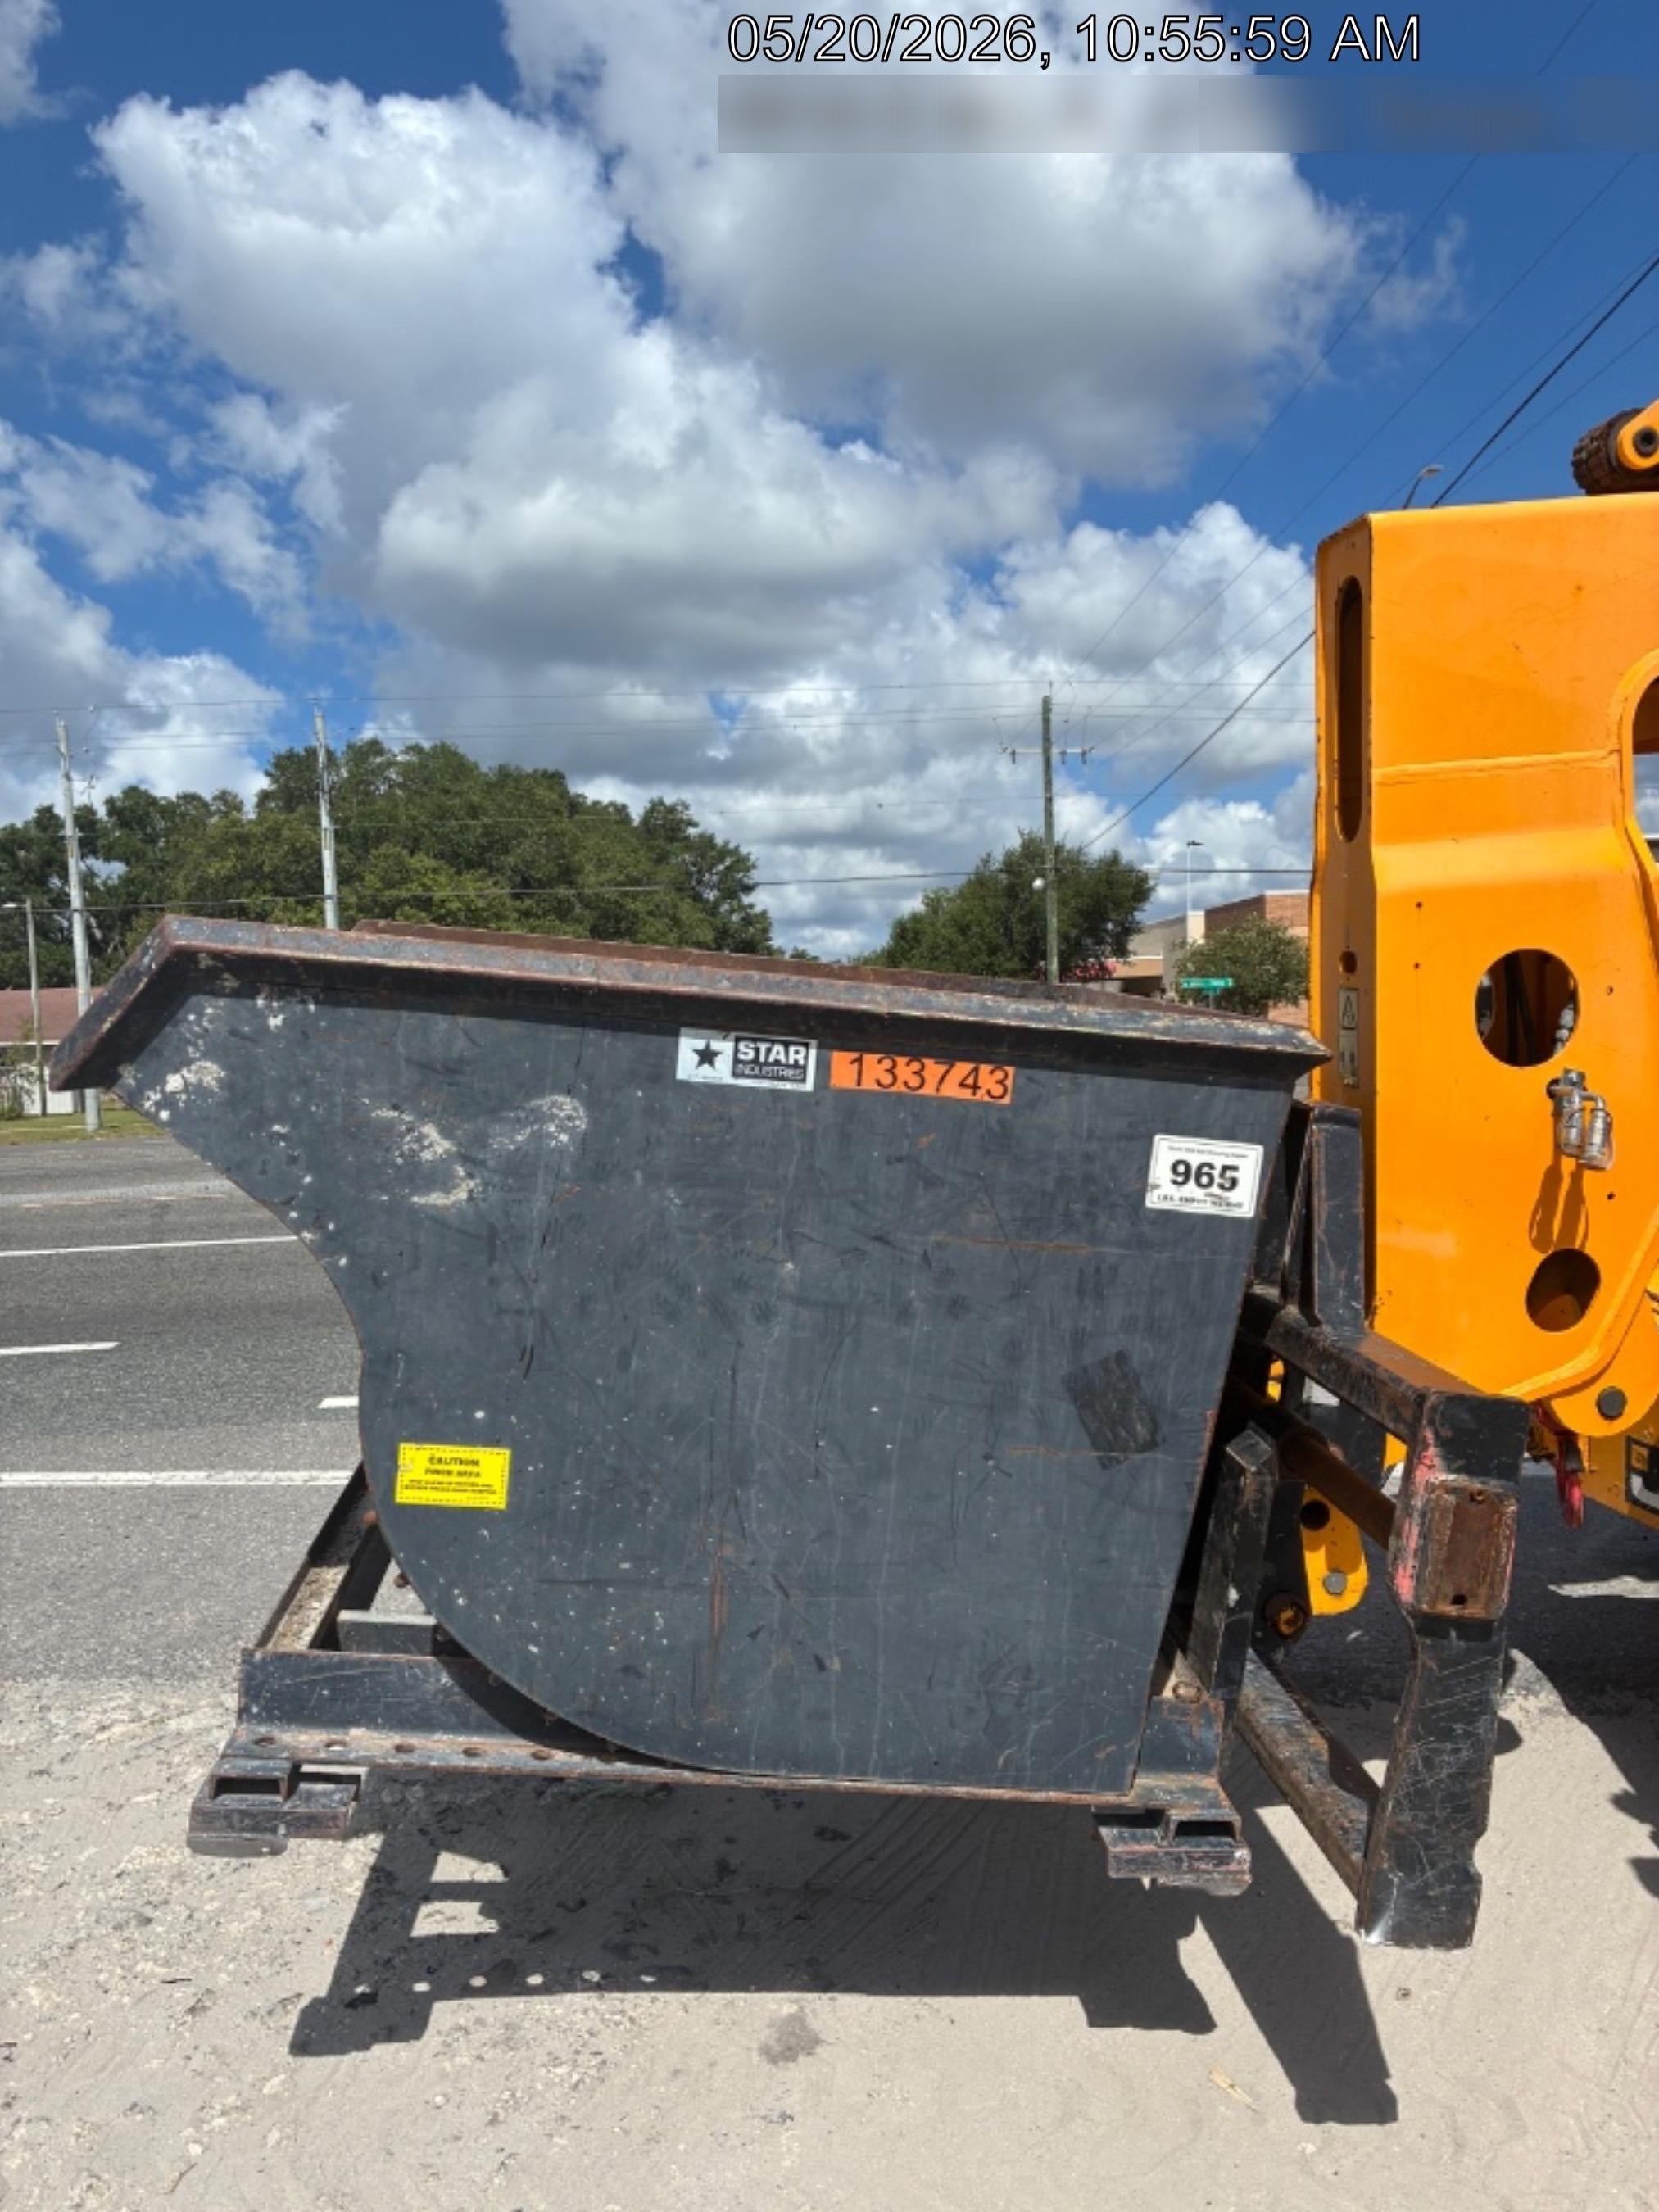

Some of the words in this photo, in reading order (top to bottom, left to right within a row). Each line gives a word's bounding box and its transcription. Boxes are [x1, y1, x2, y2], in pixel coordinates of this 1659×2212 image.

[737, 1040, 807, 1065] STAR
[735, 1063, 805, 1081] INDUSTRIES
[850, 1054, 1010, 1101] 133743
[1170, 1159, 1240, 1193] 965
